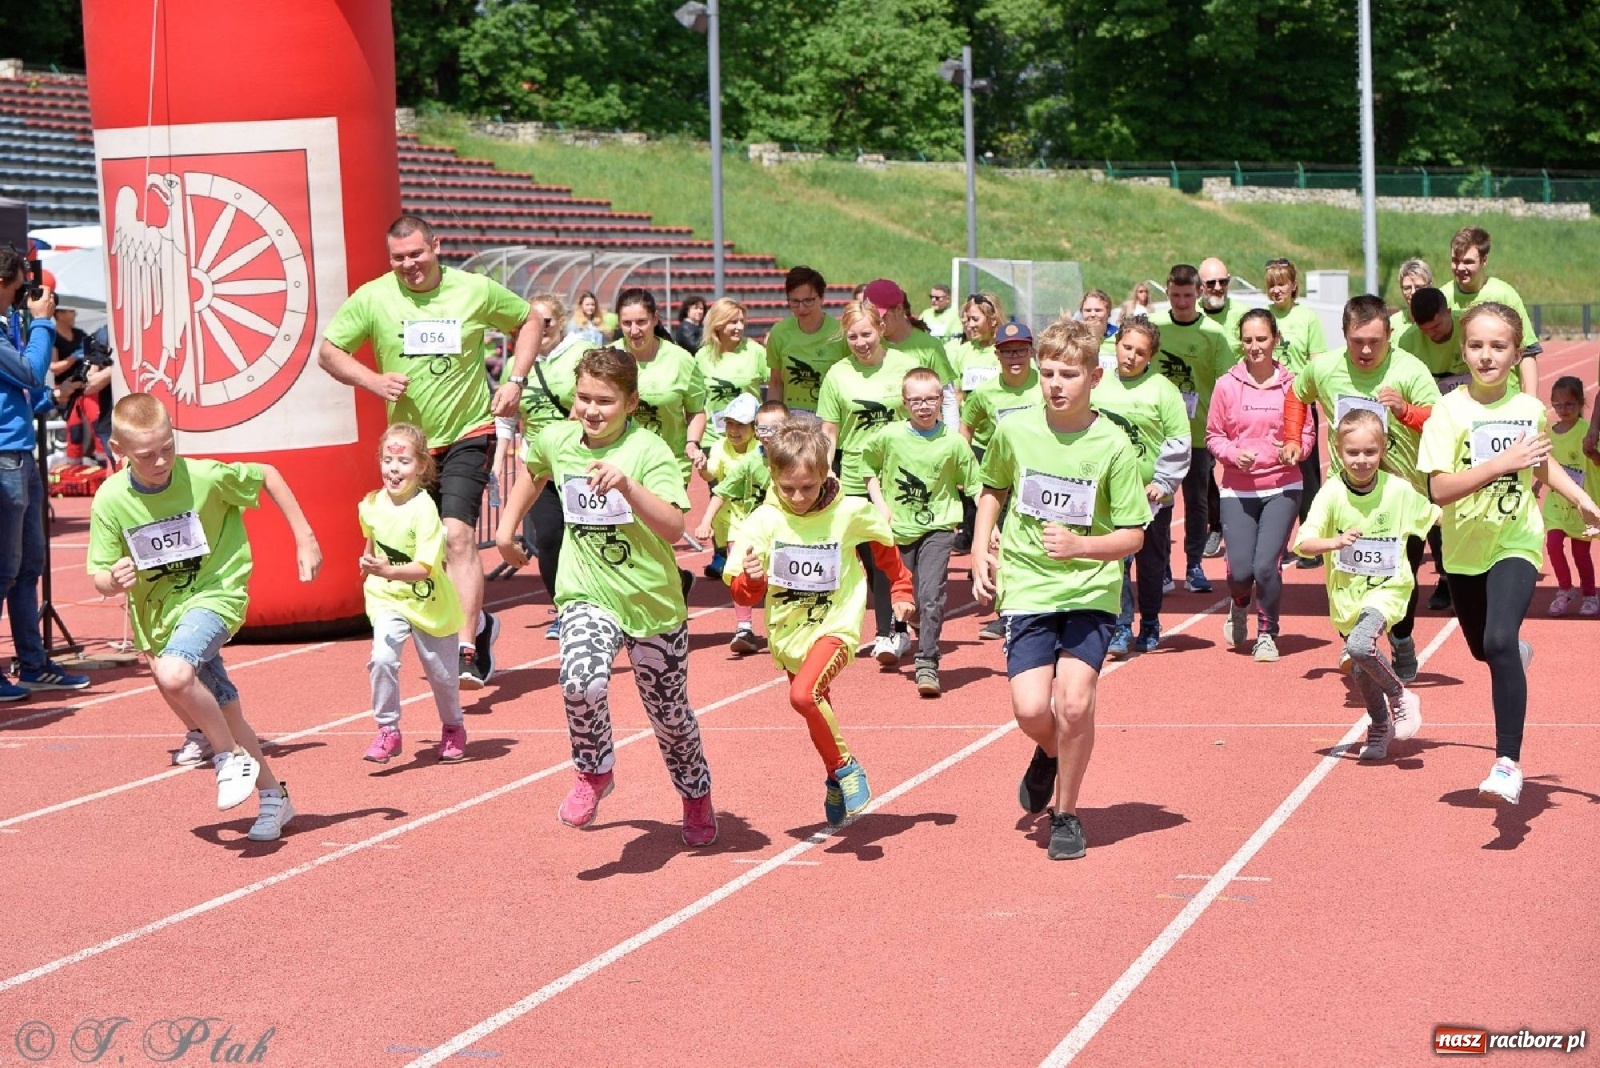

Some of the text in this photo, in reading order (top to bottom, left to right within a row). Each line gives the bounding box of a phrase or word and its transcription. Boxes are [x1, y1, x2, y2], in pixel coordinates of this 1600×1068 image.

[420, 332, 445, 344] 056
[870, 411, 884, 419] VII
[1242, 405, 1280, 413] Champion
[1491, 437, 1517, 453] 00
[909, 487, 923, 497] VII
[1041, 490, 1072, 508] 017
[578, 493, 607, 509] 069
[151, 531, 182, 551] 057
[1353, 550, 1383, 563] 053
[789, 561, 824, 577] 004
